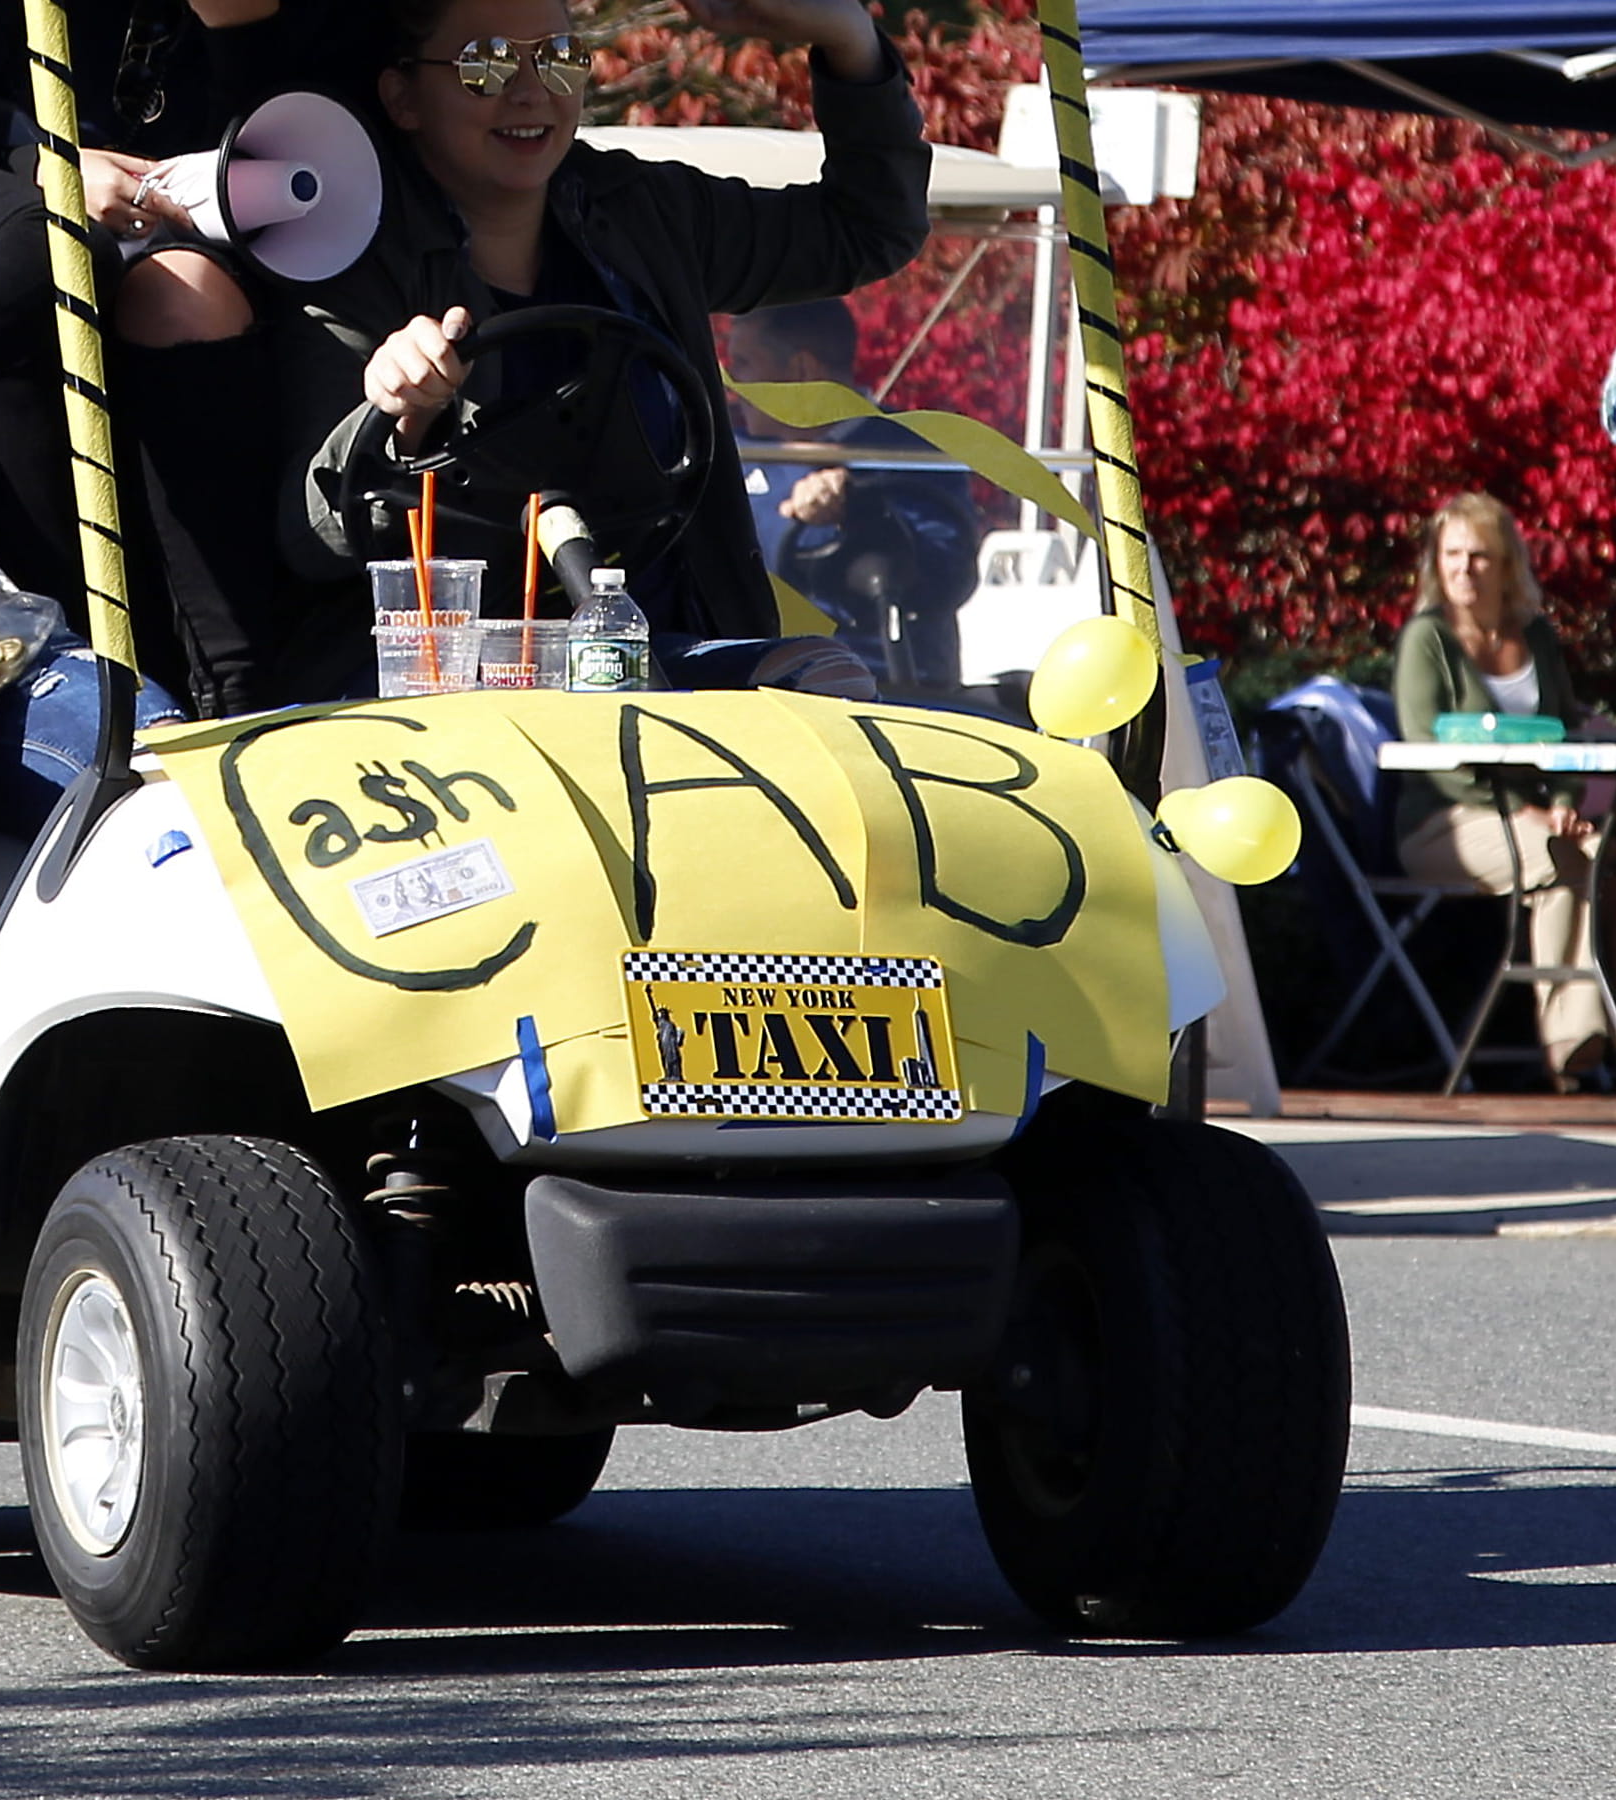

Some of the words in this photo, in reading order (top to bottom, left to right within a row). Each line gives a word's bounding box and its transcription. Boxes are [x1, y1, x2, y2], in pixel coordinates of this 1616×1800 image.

[485, 675, 534, 687] DONUTS
[721, 986, 777, 1007] NEW
[785, 987, 857, 1010] YORK
[692, 1011, 900, 1083] TAXI
